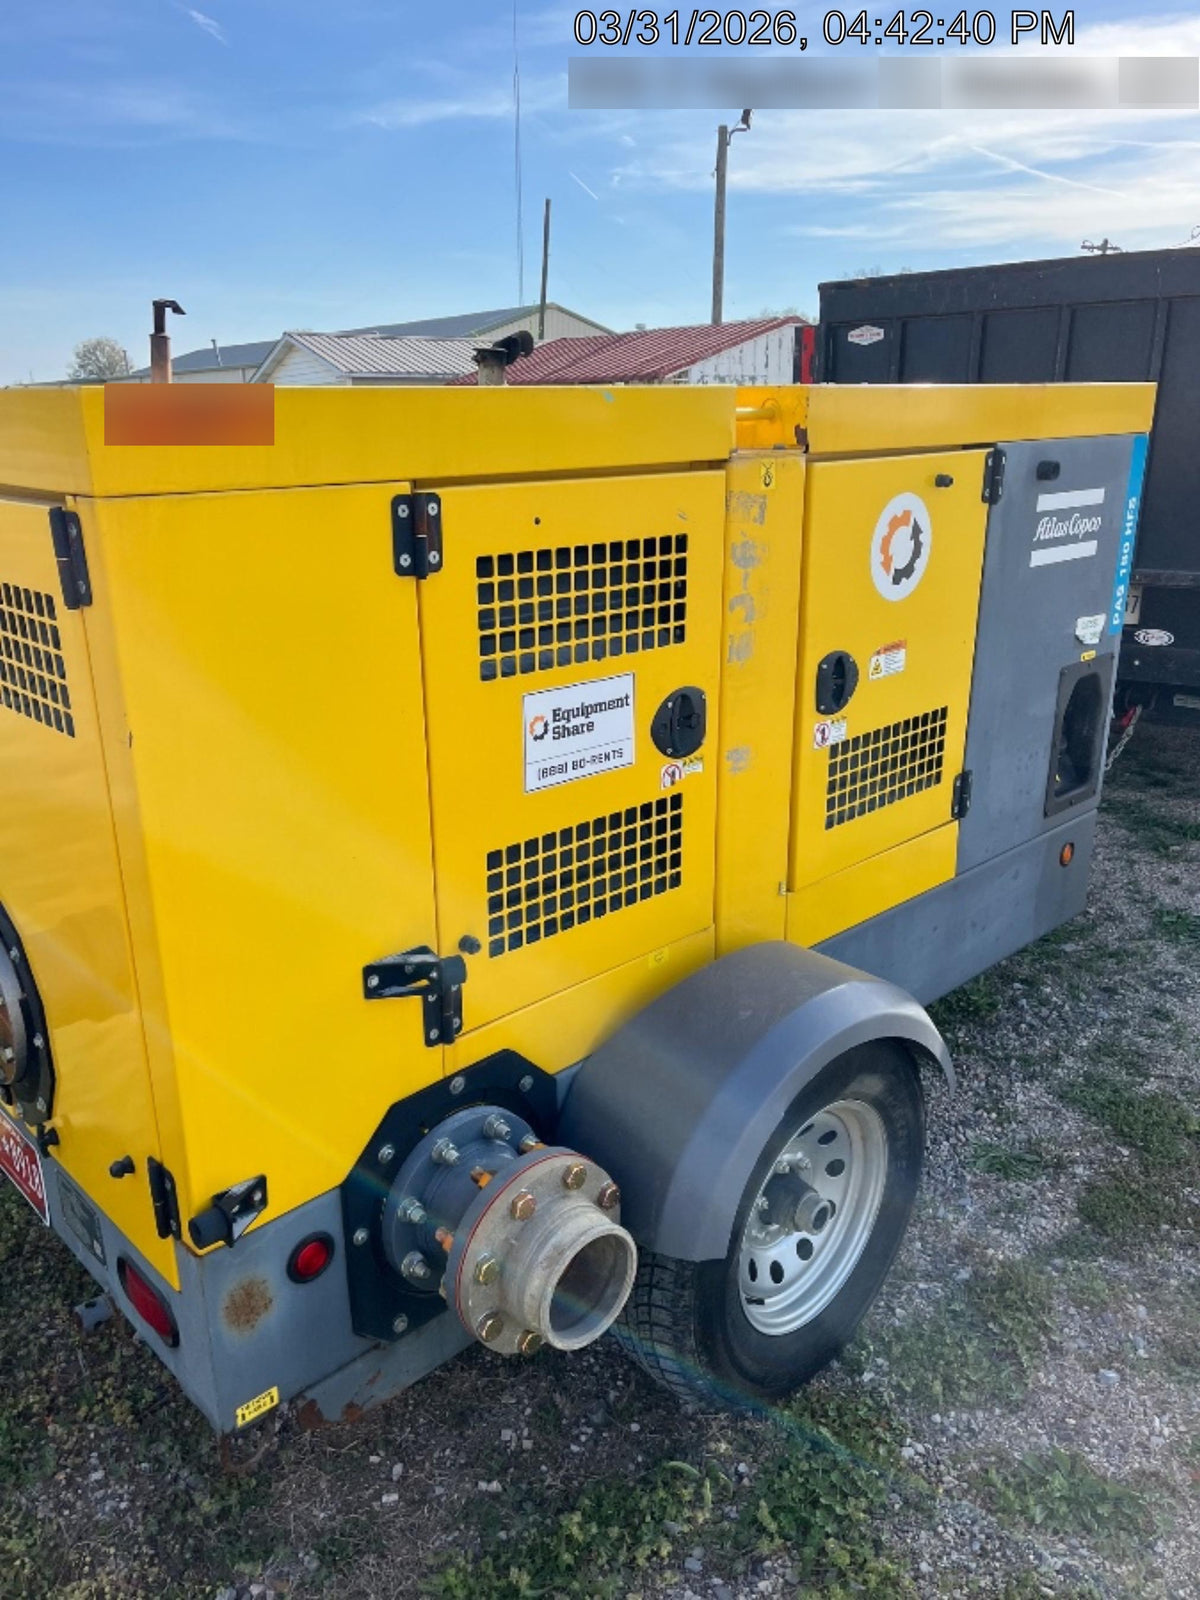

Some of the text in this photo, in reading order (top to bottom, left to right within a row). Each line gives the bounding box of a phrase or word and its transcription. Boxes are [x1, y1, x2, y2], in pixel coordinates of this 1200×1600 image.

[1033, 516, 1069, 541] Atlas
[551, 693, 630, 724] Equipment
[552, 720, 595, 741] Share
